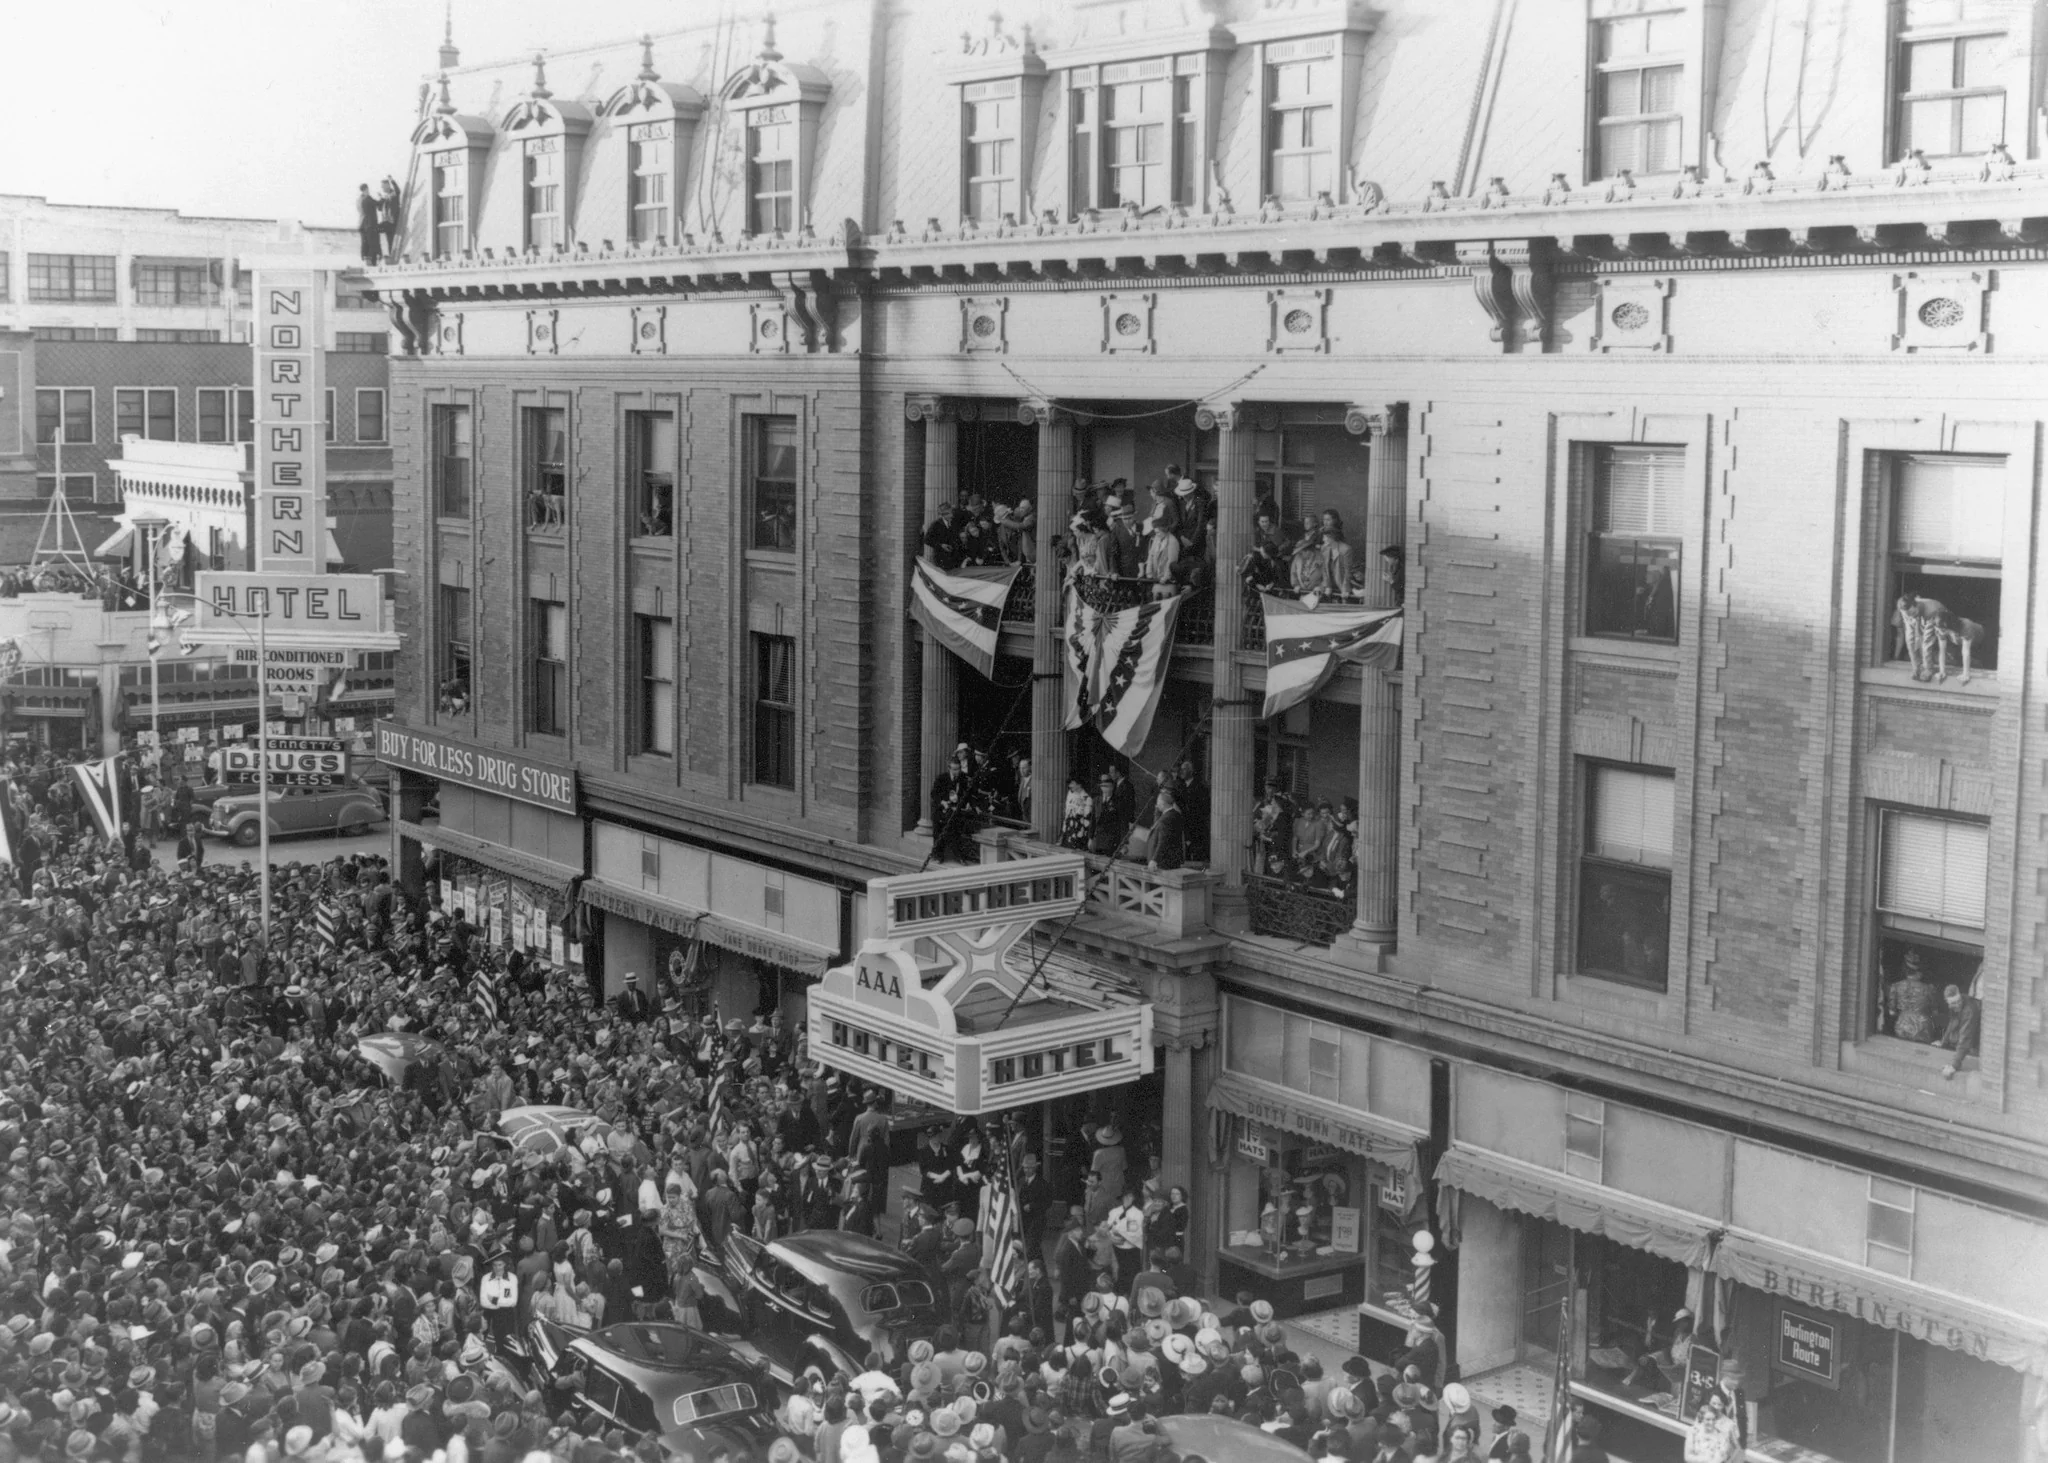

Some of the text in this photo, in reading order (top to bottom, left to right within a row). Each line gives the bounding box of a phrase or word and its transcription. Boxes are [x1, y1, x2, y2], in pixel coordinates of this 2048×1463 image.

[271, 290, 302, 554] NORTHERN
[213, 586, 361, 620] HOTEL
[236, 649, 257, 661] AIR
[266, 668, 314, 681] ROOMS
[274, 684, 308, 692] AAA
[230, 752, 339, 772] DRUGS
[381, 730, 572, 804] BUY FOR LESS DRUG STORE
[239, 773, 332, 785] FOR LESS
[895, 876, 1074, 922] NORTHERN
[856, 966, 903, 999] AAA
[832, 1020, 937, 1080] HOTEL
[994, 1037, 1124, 1085] HOTEL
[1239, 1141, 1265, 1157] HATS
[1340, 1128, 1373, 1153] HATS
[1384, 1190, 1404, 1205] HAT
[1763, 1268, 1990, 1355] BURLINGTON
[1784, 1318, 1831, 1350] Burlington
[1793, 1341, 1820, 1367] Route
